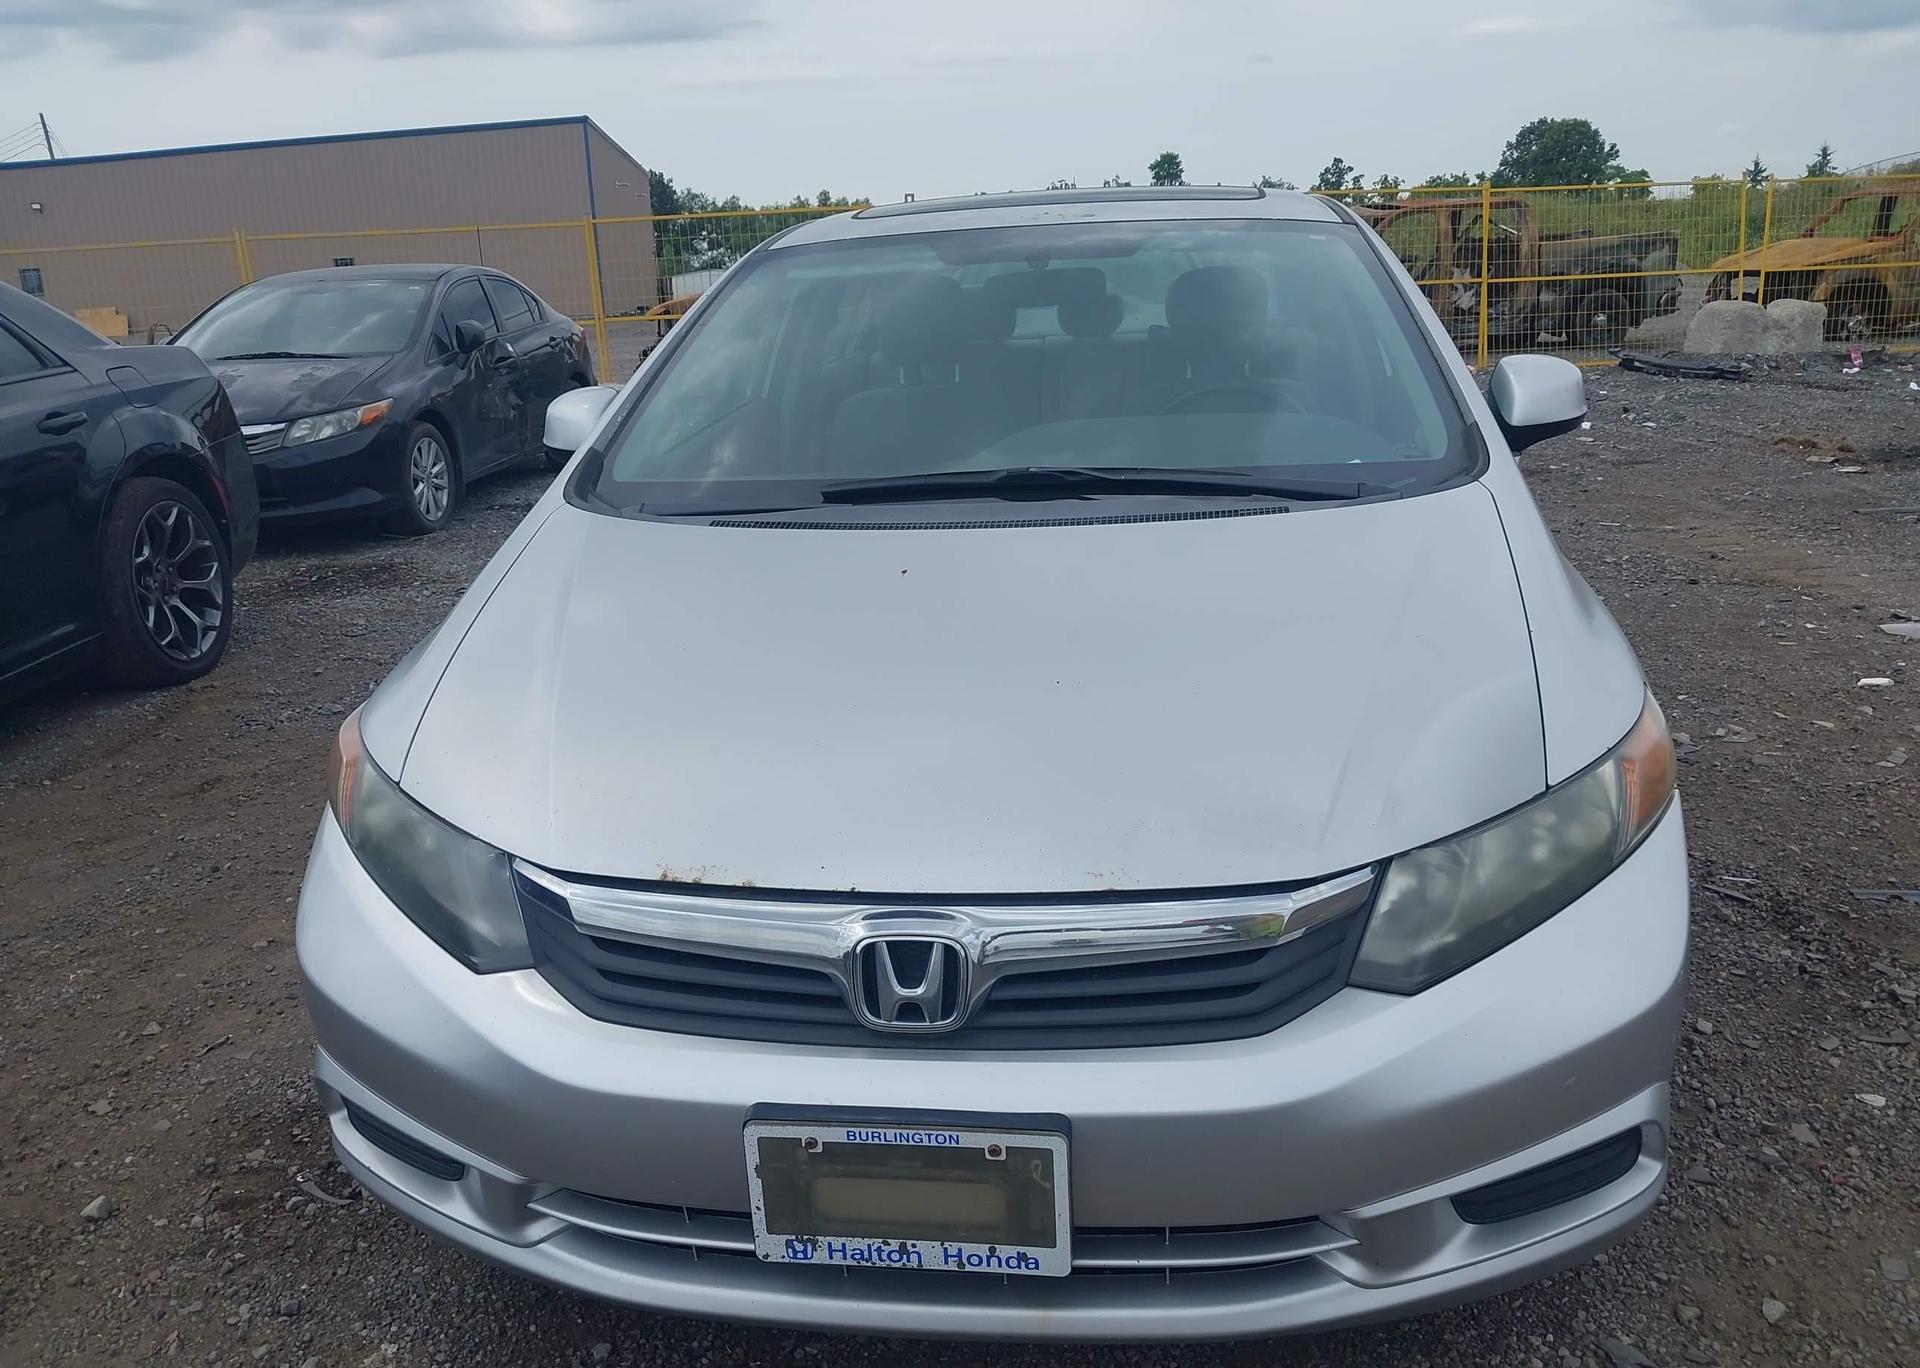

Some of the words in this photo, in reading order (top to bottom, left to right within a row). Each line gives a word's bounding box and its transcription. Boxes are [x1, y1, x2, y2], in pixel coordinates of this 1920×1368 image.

[846, 1130, 960, 1145] BURLINGTON
[827, 1241, 923, 1266] Halton
[943, 1247, 1040, 1270] Honda
